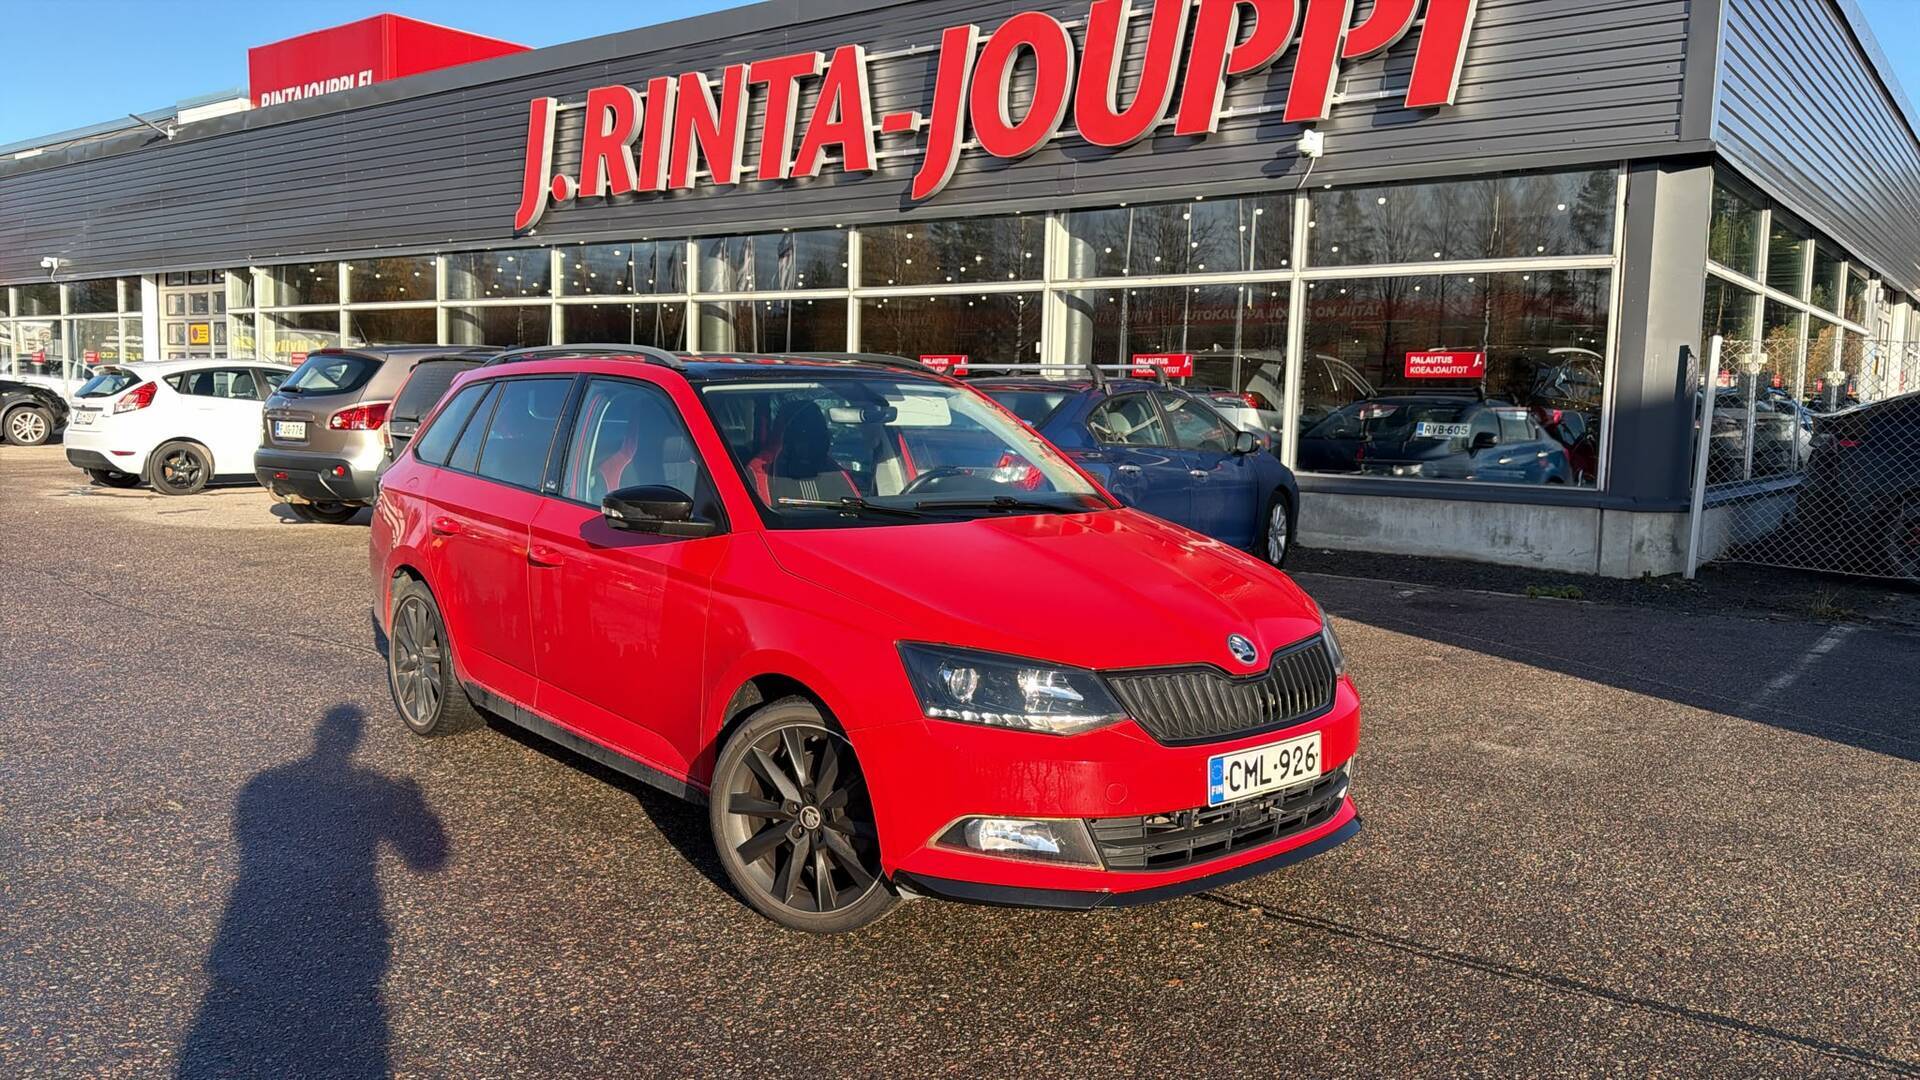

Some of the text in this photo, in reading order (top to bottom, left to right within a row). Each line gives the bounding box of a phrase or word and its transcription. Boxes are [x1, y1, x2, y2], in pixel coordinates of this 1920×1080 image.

[1410, 356, 1453, 364] PALAUTUS
[1409, 366, 1468, 374] KOEAJOAUTOT
[1424, 424, 1468, 435] RVB-605
[1228, 741, 1316, 792] CML-926
